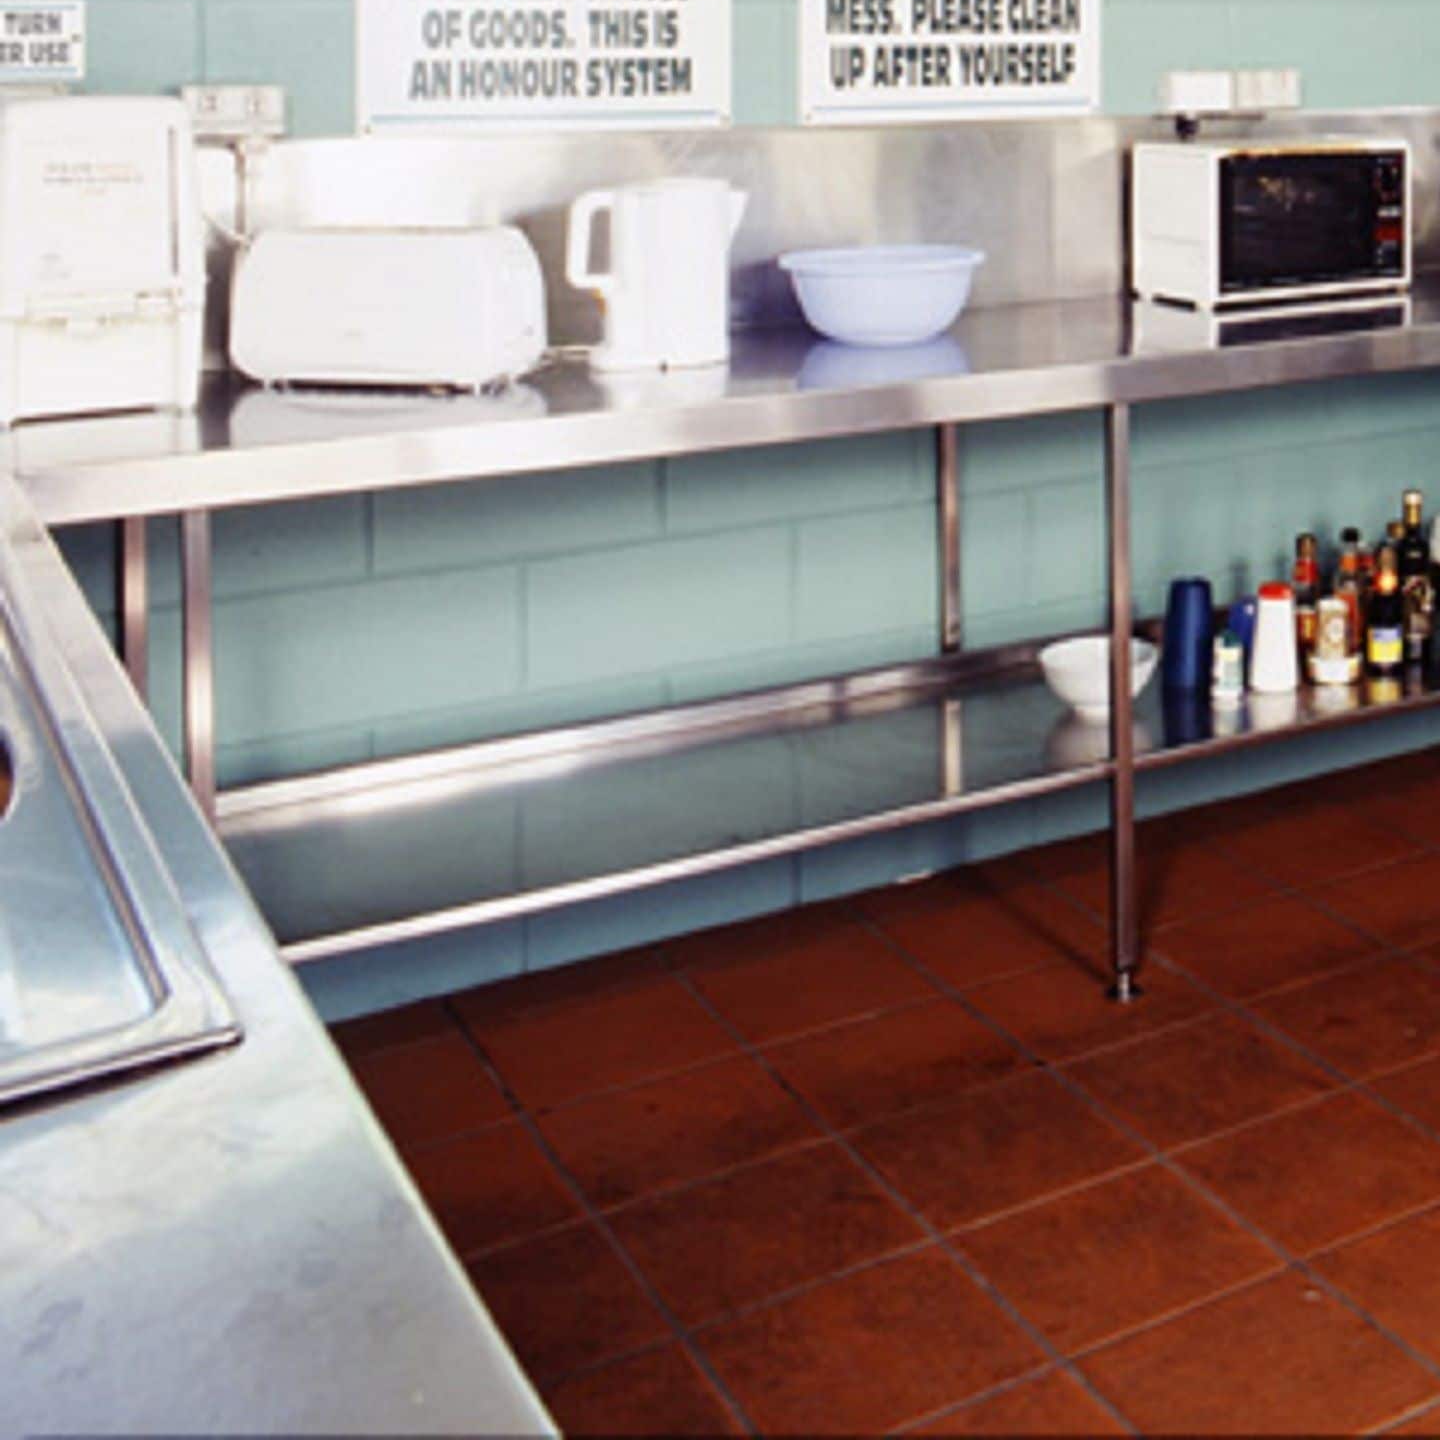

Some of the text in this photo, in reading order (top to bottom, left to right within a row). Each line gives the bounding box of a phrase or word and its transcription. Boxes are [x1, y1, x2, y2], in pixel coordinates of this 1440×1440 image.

[5, 13, 62, 35] TURN
[422, 10, 678, 48] OF GOODS. THIS IS
[29, 42, 69, 63] USE
[830, 43, 1075, 88] UP AFTER YOURSELF
[409, 58, 692, 100] AN HONOUR SYSTEM
